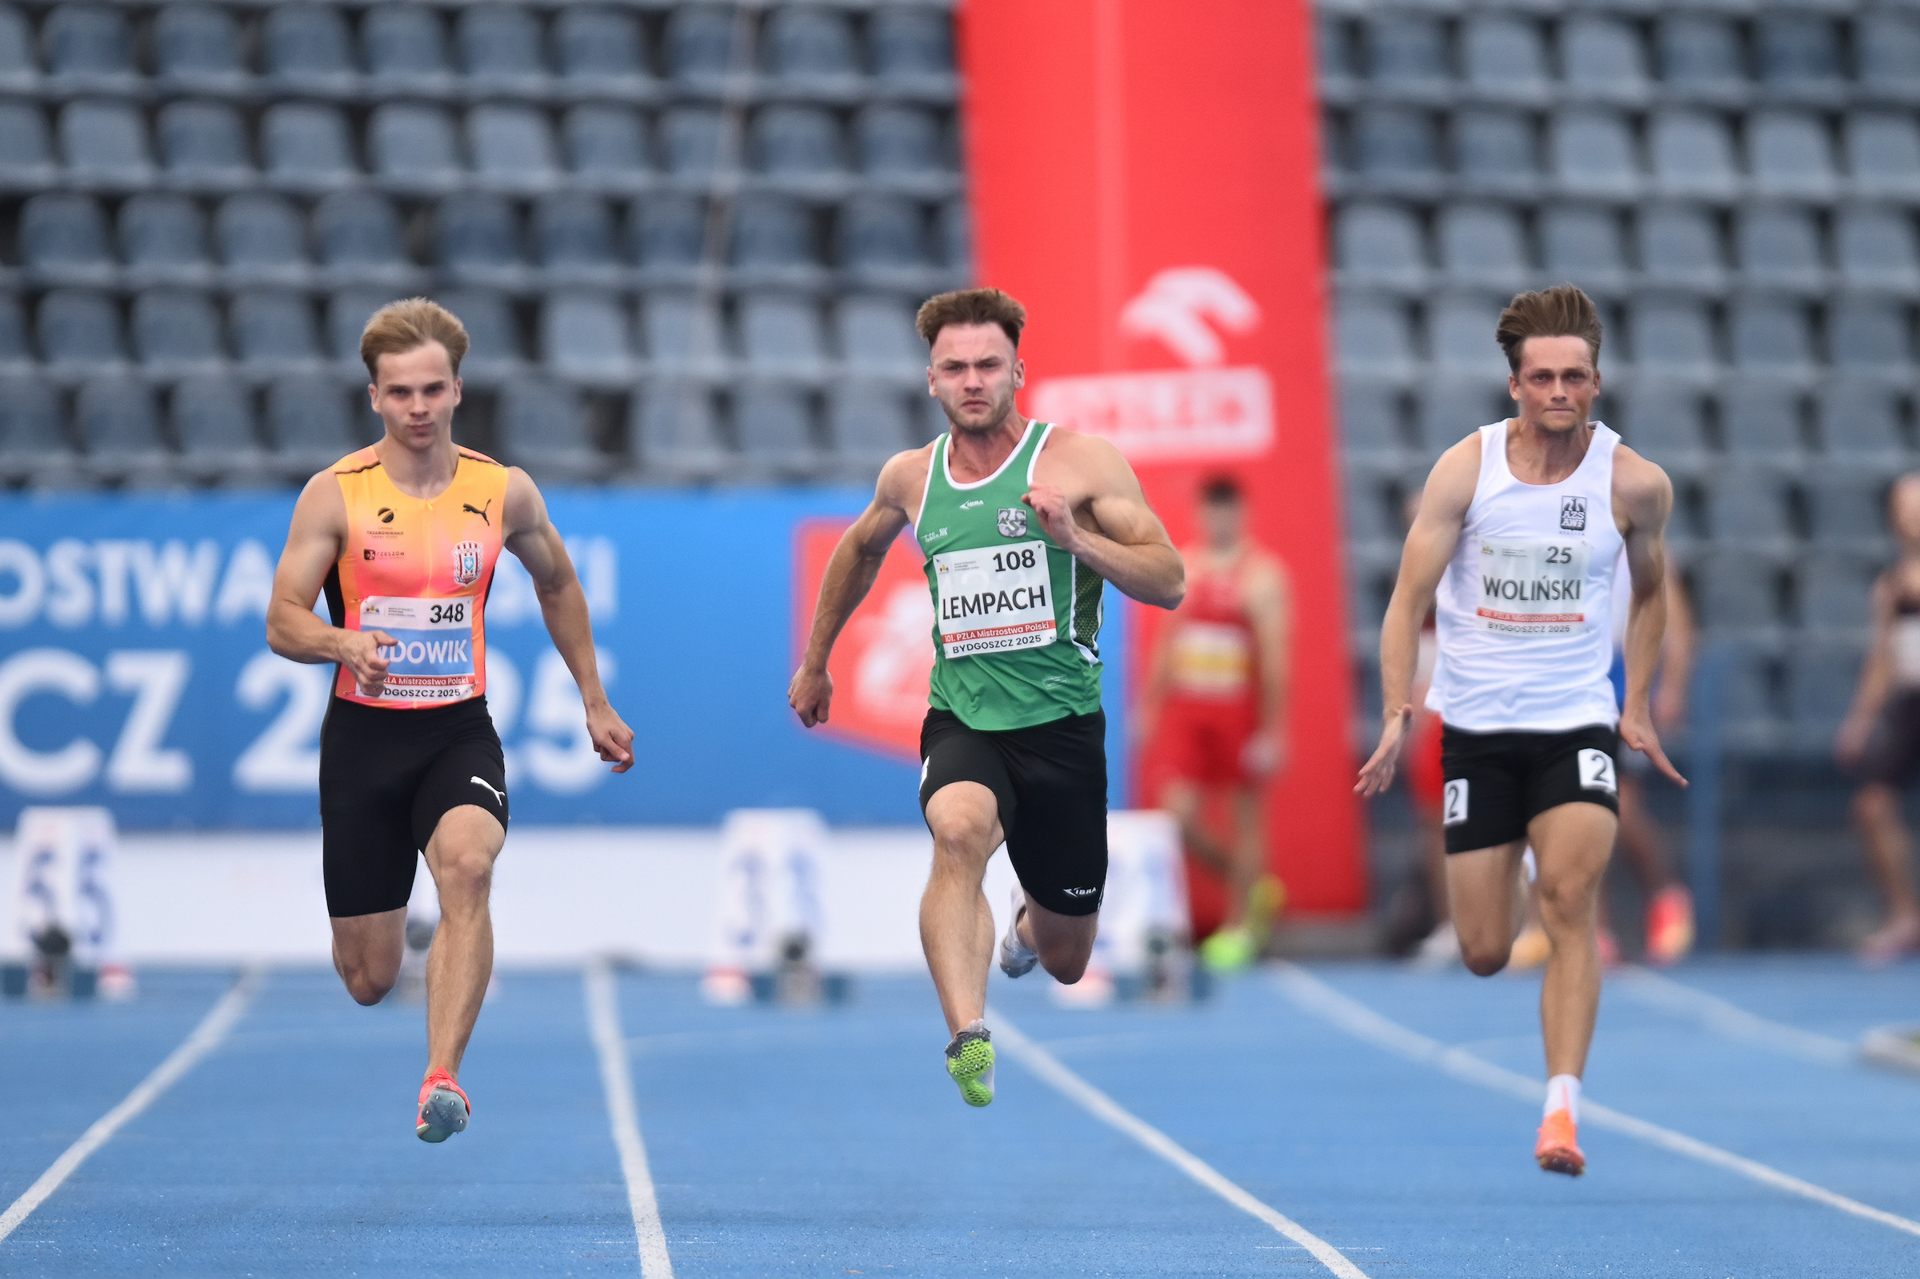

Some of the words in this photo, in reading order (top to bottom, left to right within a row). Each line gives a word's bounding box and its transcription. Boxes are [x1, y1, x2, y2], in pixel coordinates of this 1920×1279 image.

[1562, 511, 1585, 519] AZS
[992, 548, 1036, 573] 108
[1545, 546, 1573, 564] 25
[1483, 574, 1581, 601] WOLIŃSKI
[429, 602, 464, 623] 348
[942, 585, 1047, 620] LEMPACH
[957, 632, 976, 641] PZLA
[977, 626, 1024, 638] Mistrzostwa
[1025, 621, 1049, 632] Polski
[1488, 622, 1546, 632] BYDGOSZCZ
[952, 638, 1014, 654] BYDGOSZCZ
[1015, 635, 1042, 646] 2025
[399, 677, 446, 686] Mistrzostwa
[447, 676, 469, 685] Polski
[384, 688, 435, 698] DGOSZCZ
[437, 688, 461, 698] 2025
[1591, 753, 1610, 784] 2
[1447, 784, 1458, 819] 2
